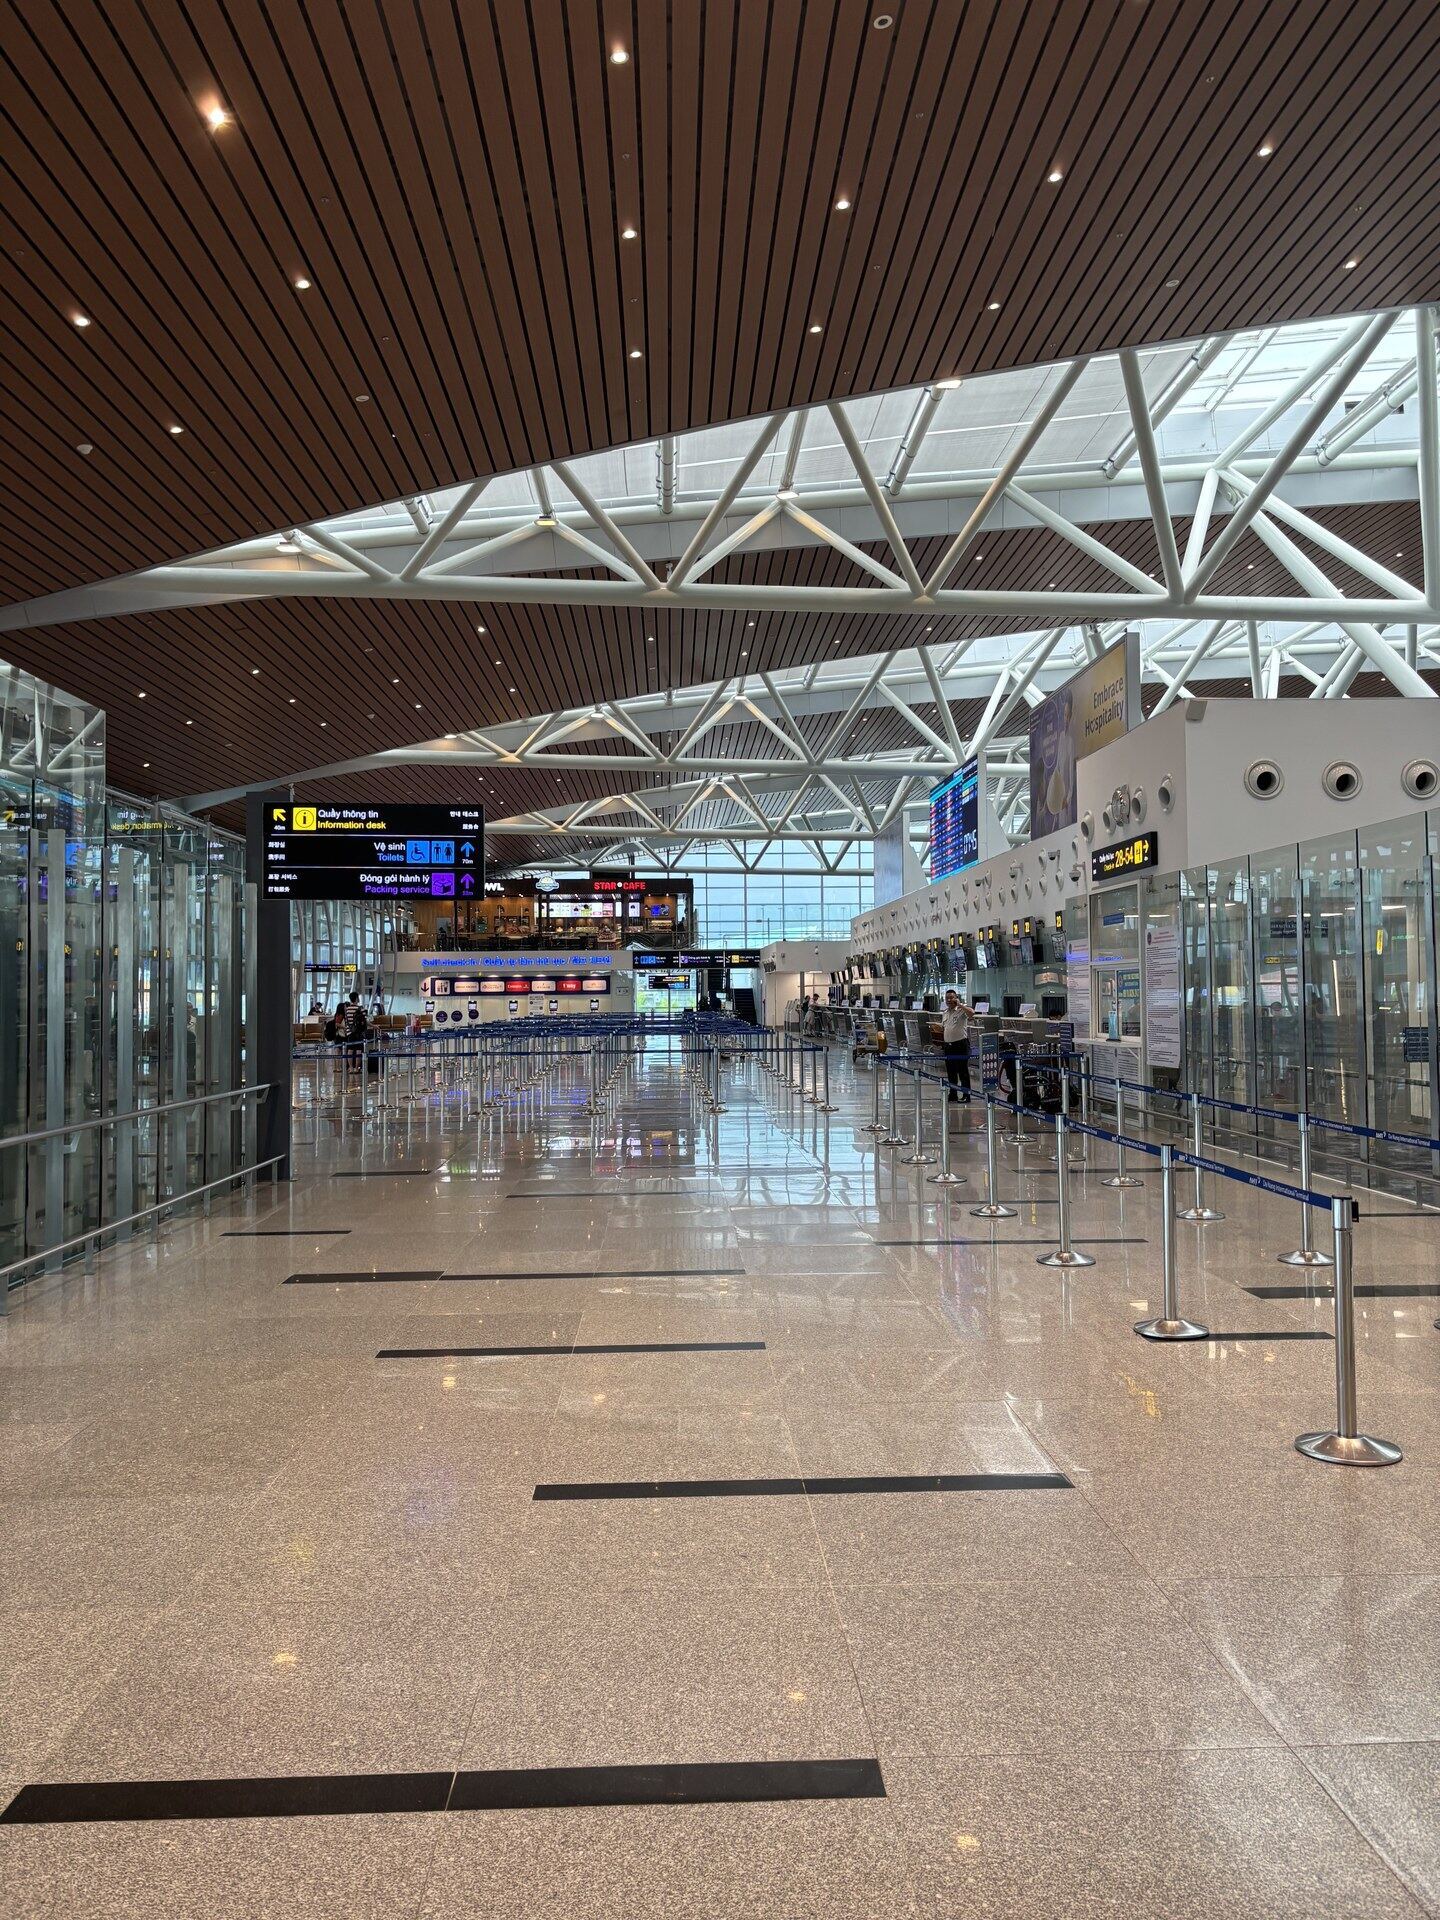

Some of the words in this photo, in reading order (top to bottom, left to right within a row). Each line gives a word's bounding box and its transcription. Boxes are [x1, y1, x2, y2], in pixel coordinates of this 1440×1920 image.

[1093, 676, 1124, 709] Embrace
[1084, 700, 1124, 737] Hospitality
[318, 808, 341, 819] Quầy
[342, 809, 367, 820] thông
[368, 809, 379, 819] tin
[317, 821, 364, 829] Information
[366, 821, 387, 829] desk
[373, 841, 387, 852] Vệ
[387, 842, 406, 851] sinh
[377, 853, 405, 862] Toilets
[1115, 845, 1134, 868] 28-54
[360, 874, 383, 884] Đóng
[384, 874, 398, 884] gói
[399, 874, 421, 883] hành
[422, 874, 430, 884] lý
[364, 885, 399, 894] Packing
[400, 885, 430, 894] service
[593, 881, 617, 891] STAR
[622, 881, 646, 890] CAFE
[1267, 1181, 1276, 1191] Nang
[1275, 1184, 1296, 1197] International
[1294, 1189, 1310, 1201] Terminal
